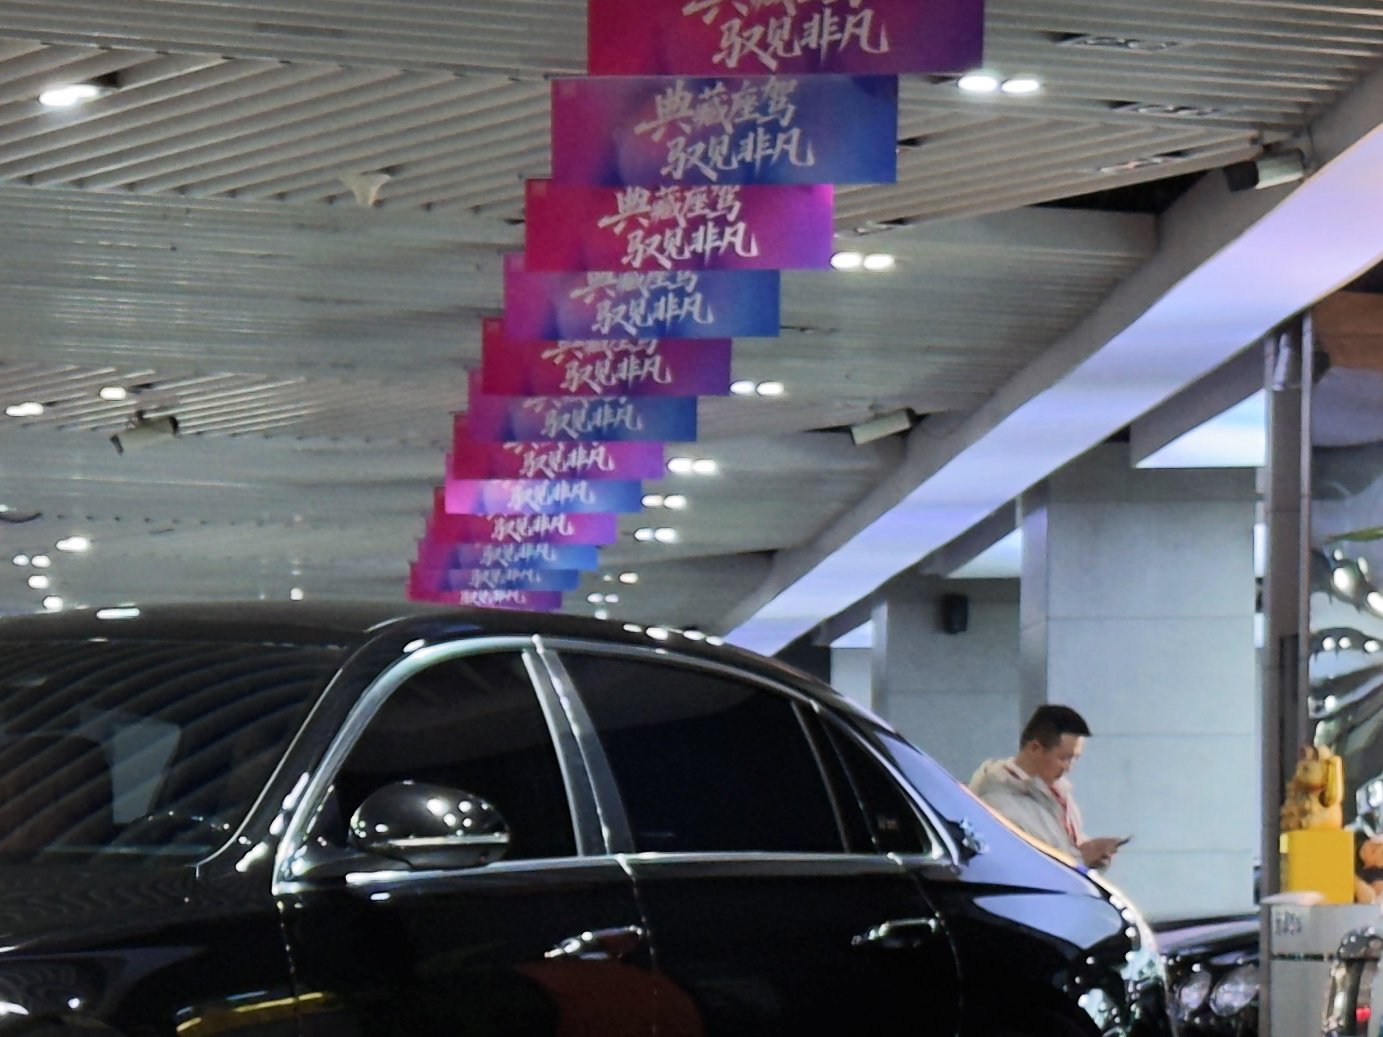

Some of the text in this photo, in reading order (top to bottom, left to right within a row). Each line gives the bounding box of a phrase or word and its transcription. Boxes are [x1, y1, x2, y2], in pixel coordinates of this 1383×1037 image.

[711, 9, 890, 72] 驭见非凡
[634, 76, 799, 142] 典藏座驾
[659, 129, 815, 182] 驭见非凡
[597, 185, 741, 235] 典藏座驾
[620, 221, 759, 270] 驭见非凡
[591, 292, 714, 335] 驭见非凡
[559, 355, 673, 395] 驭见非凡
[541, 402, 644, 439] 驭见非凡
